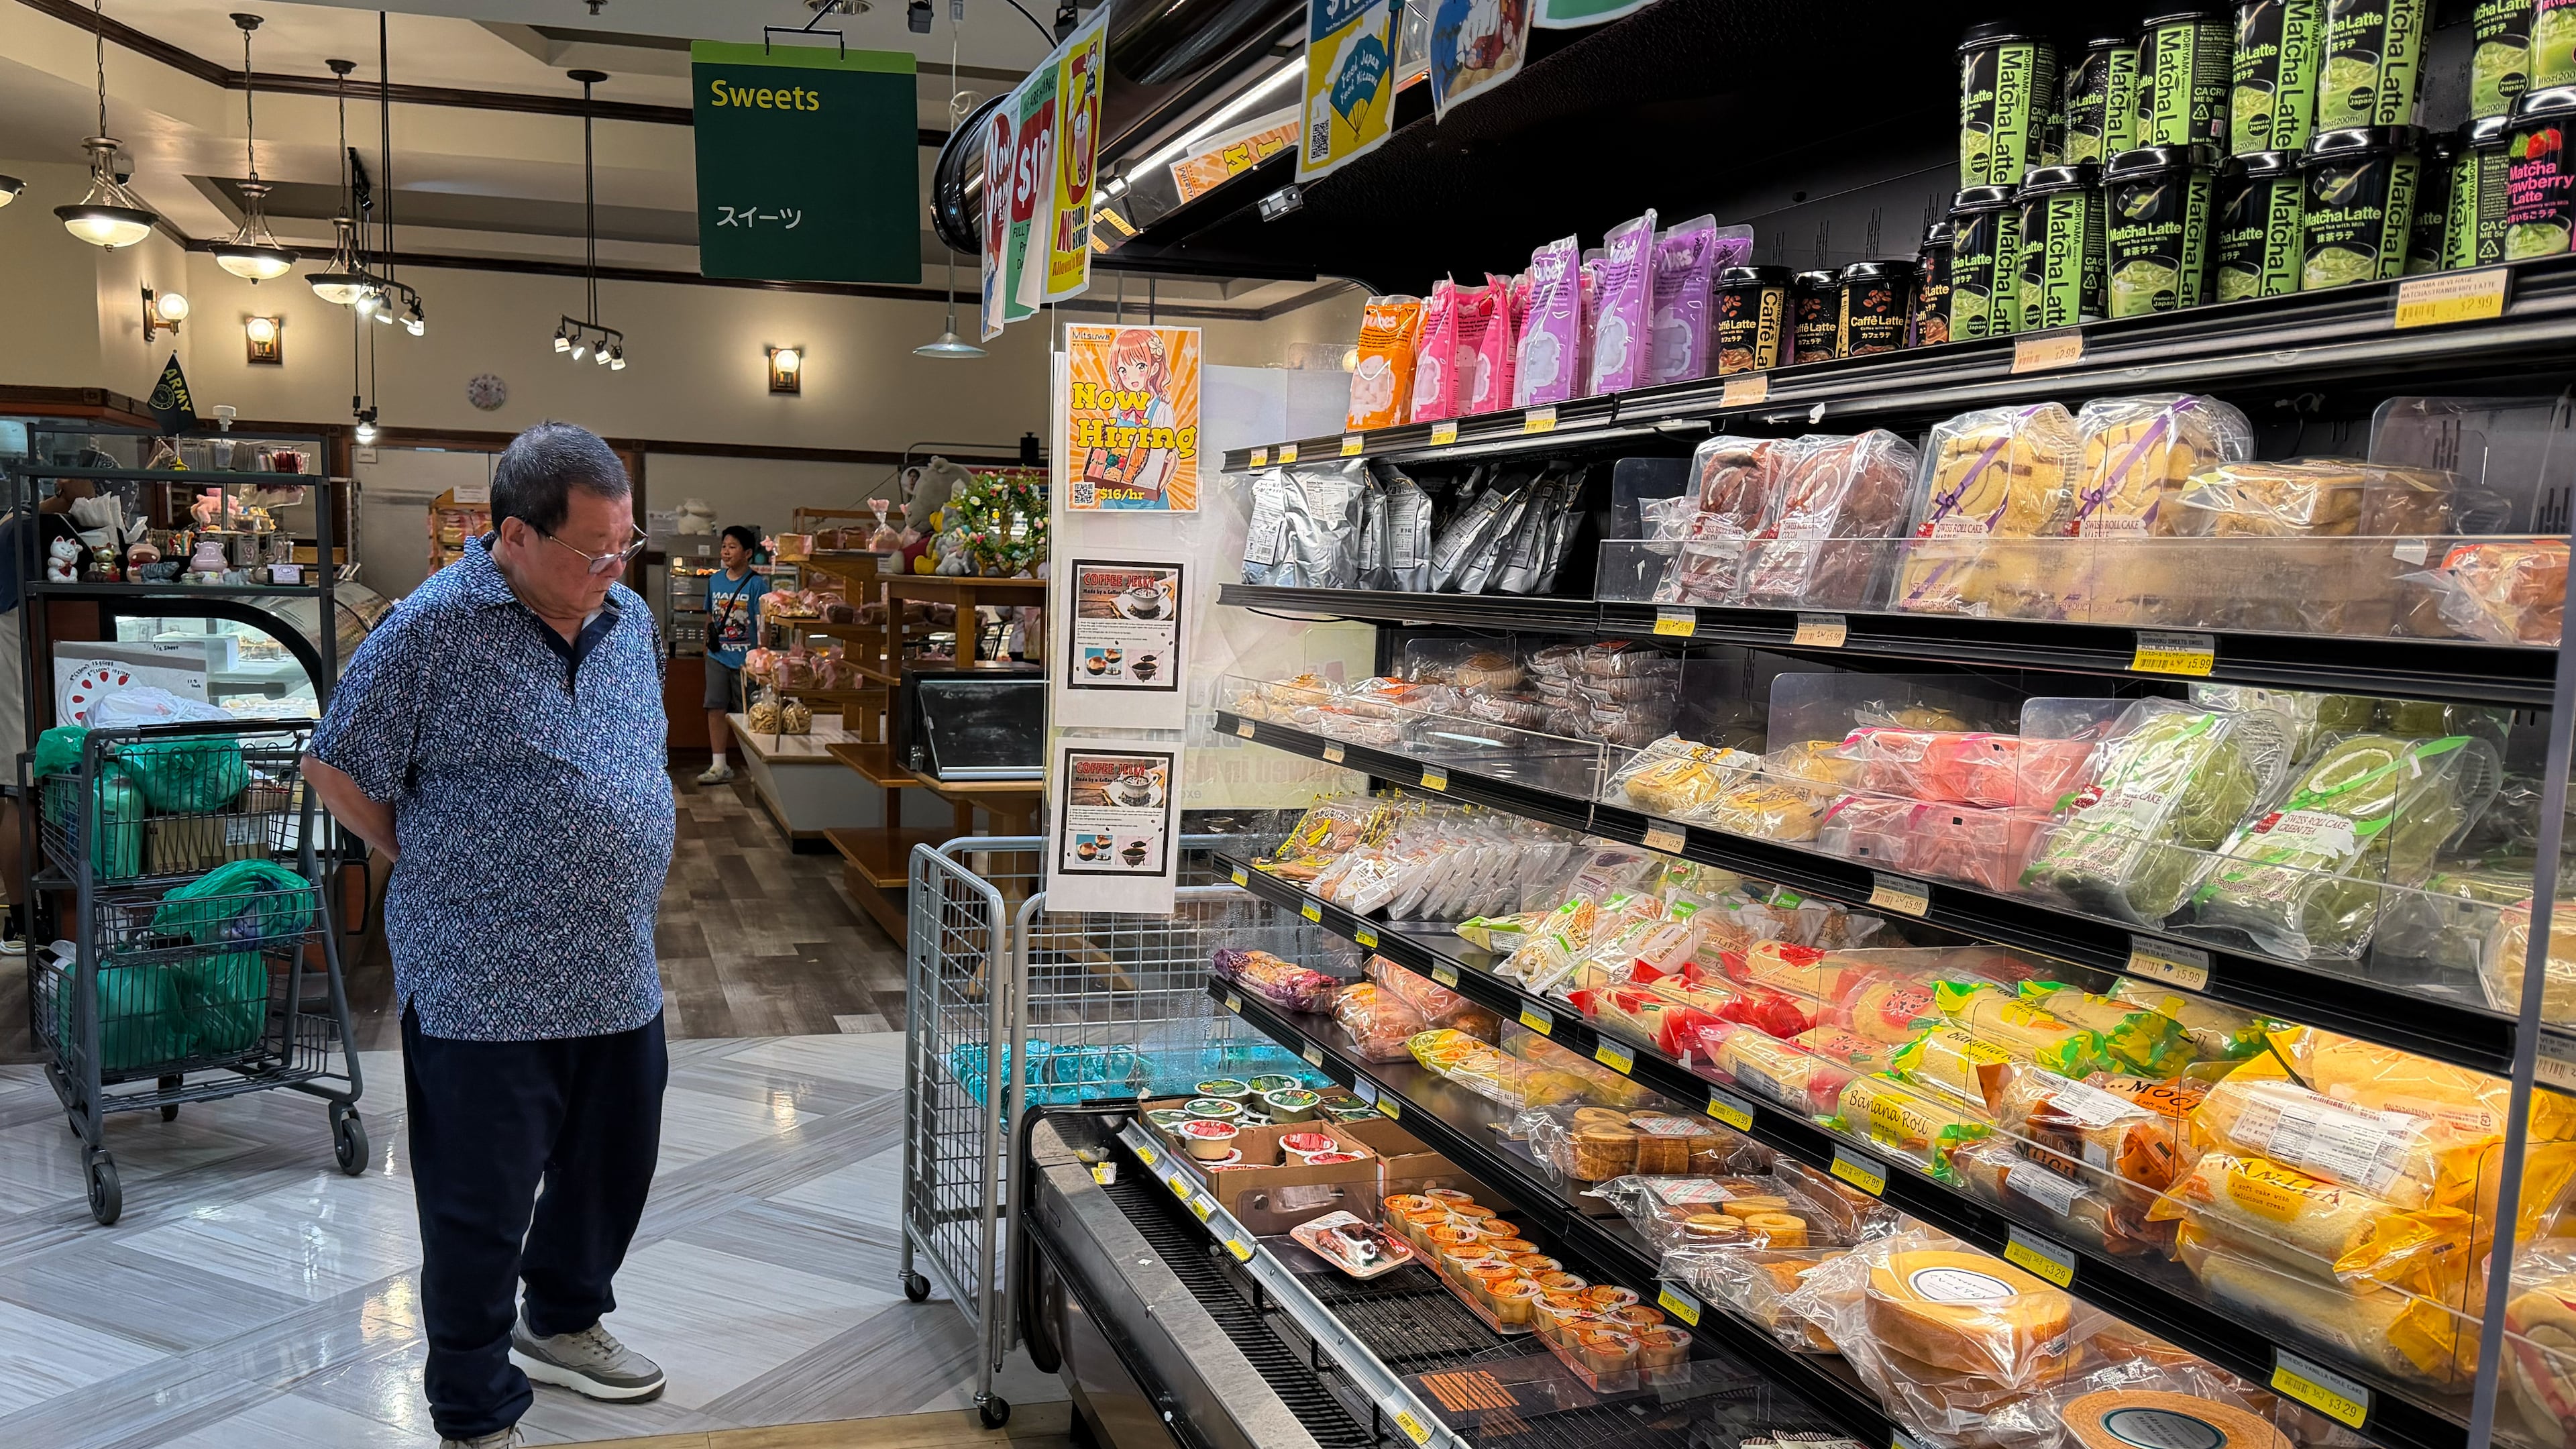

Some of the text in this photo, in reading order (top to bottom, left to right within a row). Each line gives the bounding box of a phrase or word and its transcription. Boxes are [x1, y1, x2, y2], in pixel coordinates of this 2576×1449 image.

[2346, 11, 2383, 29] Latte
[2181, 28, 2191, 75] MORIYAMA
[2246, 44, 2277, 60] Latte
[1360, 50, 1379, 70] Japan
[2021, 50, 2032, 94] MORIYAMA
[2157, 30, 2182, 112] Matcha
[2275, 0, 2313, 148] Matcha Latte
[2108, 54, 2135, 131] Matcha
[2194, 87, 2226, 97] CA CRV
[2379, 62, 2408, 123] Latte
[2500, 83, 2524, 92] Japan
[711, 80, 820, 111] Sweets
[1969, 90, 1993, 104] Latte
[2077, 93, 2104, 107] Latte
[1994, 50, 2023, 183] Matcha Latte
[2510, 161, 2557, 181] Matcha
[2513, 191, 2543, 205] Latte
[2384, 164, 2415, 253] Matcha
[716, 205, 802, 229] スイーツ
[2073, 199, 2082, 245] MORIYAMA
[2185, 182, 2208, 264] Matcha
[2305, 207, 2382, 227] Matcha Latte
[1057, 209, 1073, 254] NO
[2110, 221, 2182, 242] Matcha Latte
[2268, 186, 2299, 269] Matcha
[2481, 221, 2496, 231] CA
[2048, 200, 2074, 279] Matcha
[2233, 227, 2263, 241] Latte
[2317, 231, 2355, 244] 抹茶ラテ
[1996, 217, 2019, 292] Matcha
[2022, 240, 2043, 255] Latte
[2123, 245, 2158, 257] 抹茶ラテ
[1965, 254, 1992, 266] Latte
[2085, 257, 2097, 266] CA
[1927, 284, 1949, 297] Latte
[1731, 320, 1756, 329] Latte
[1810, 323, 1836, 332] Latte
[1851, 315, 1904, 327] Caffè Latte
[1072, 330, 1110, 341] Mitsuwa
[163, 368, 192, 413] ARMY
[1072, 382, 1150, 411] Now
[1077, 418, 1197, 459] Hiring
[1099, 488, 1145, 501] $16/hr
[1937, 524, 1982, 534] SWISS ROLL CAKE
[2085, 521, 2139, 530] SWISS ROLL CAKE
[1083, 573, 1157, 587] COFFEE JELLY
[1936, 601, 1957, 611] JAPAN
[2188, 659, 2210, 669] $5.99
[1076, 762, 1146, 775] COFFEE JELLY
[2122, 800, 2133, 808] TEA
[2139, 792, 2163, 805] CAKE
[2277, 823, 2316, 835] GREEN TEA
[2285, 814, 2349, 830] SWISS ROLL CAKE
[2211, 877, 2253, 894] PRODUCT
[2252, 887, 2263, 896] OF
[1778, 898, 1796, 907] Pasco
[1904, 900, 1922, 910] $5.99
[2134, 940, 2152, 948] CLOVER
[2176, 969, 2200, 983] $5.99
[1849, 1089, 1929, 1135] Banana Roll
[2036, 1132, 2077, 1156] Roll Cake
[1863, 1175, 1880, 1188] $2.99
[2238, 1184, 2290, 1203] soft cake with
[2233, 1193, 2286, 1211] delicious cream
[2045, 1265, 2065, 1280] $3.29
[2304, 1365, 2362, 1395] VANILLA CAKE
[2328, 1399, 2357, 1417] $3.29
